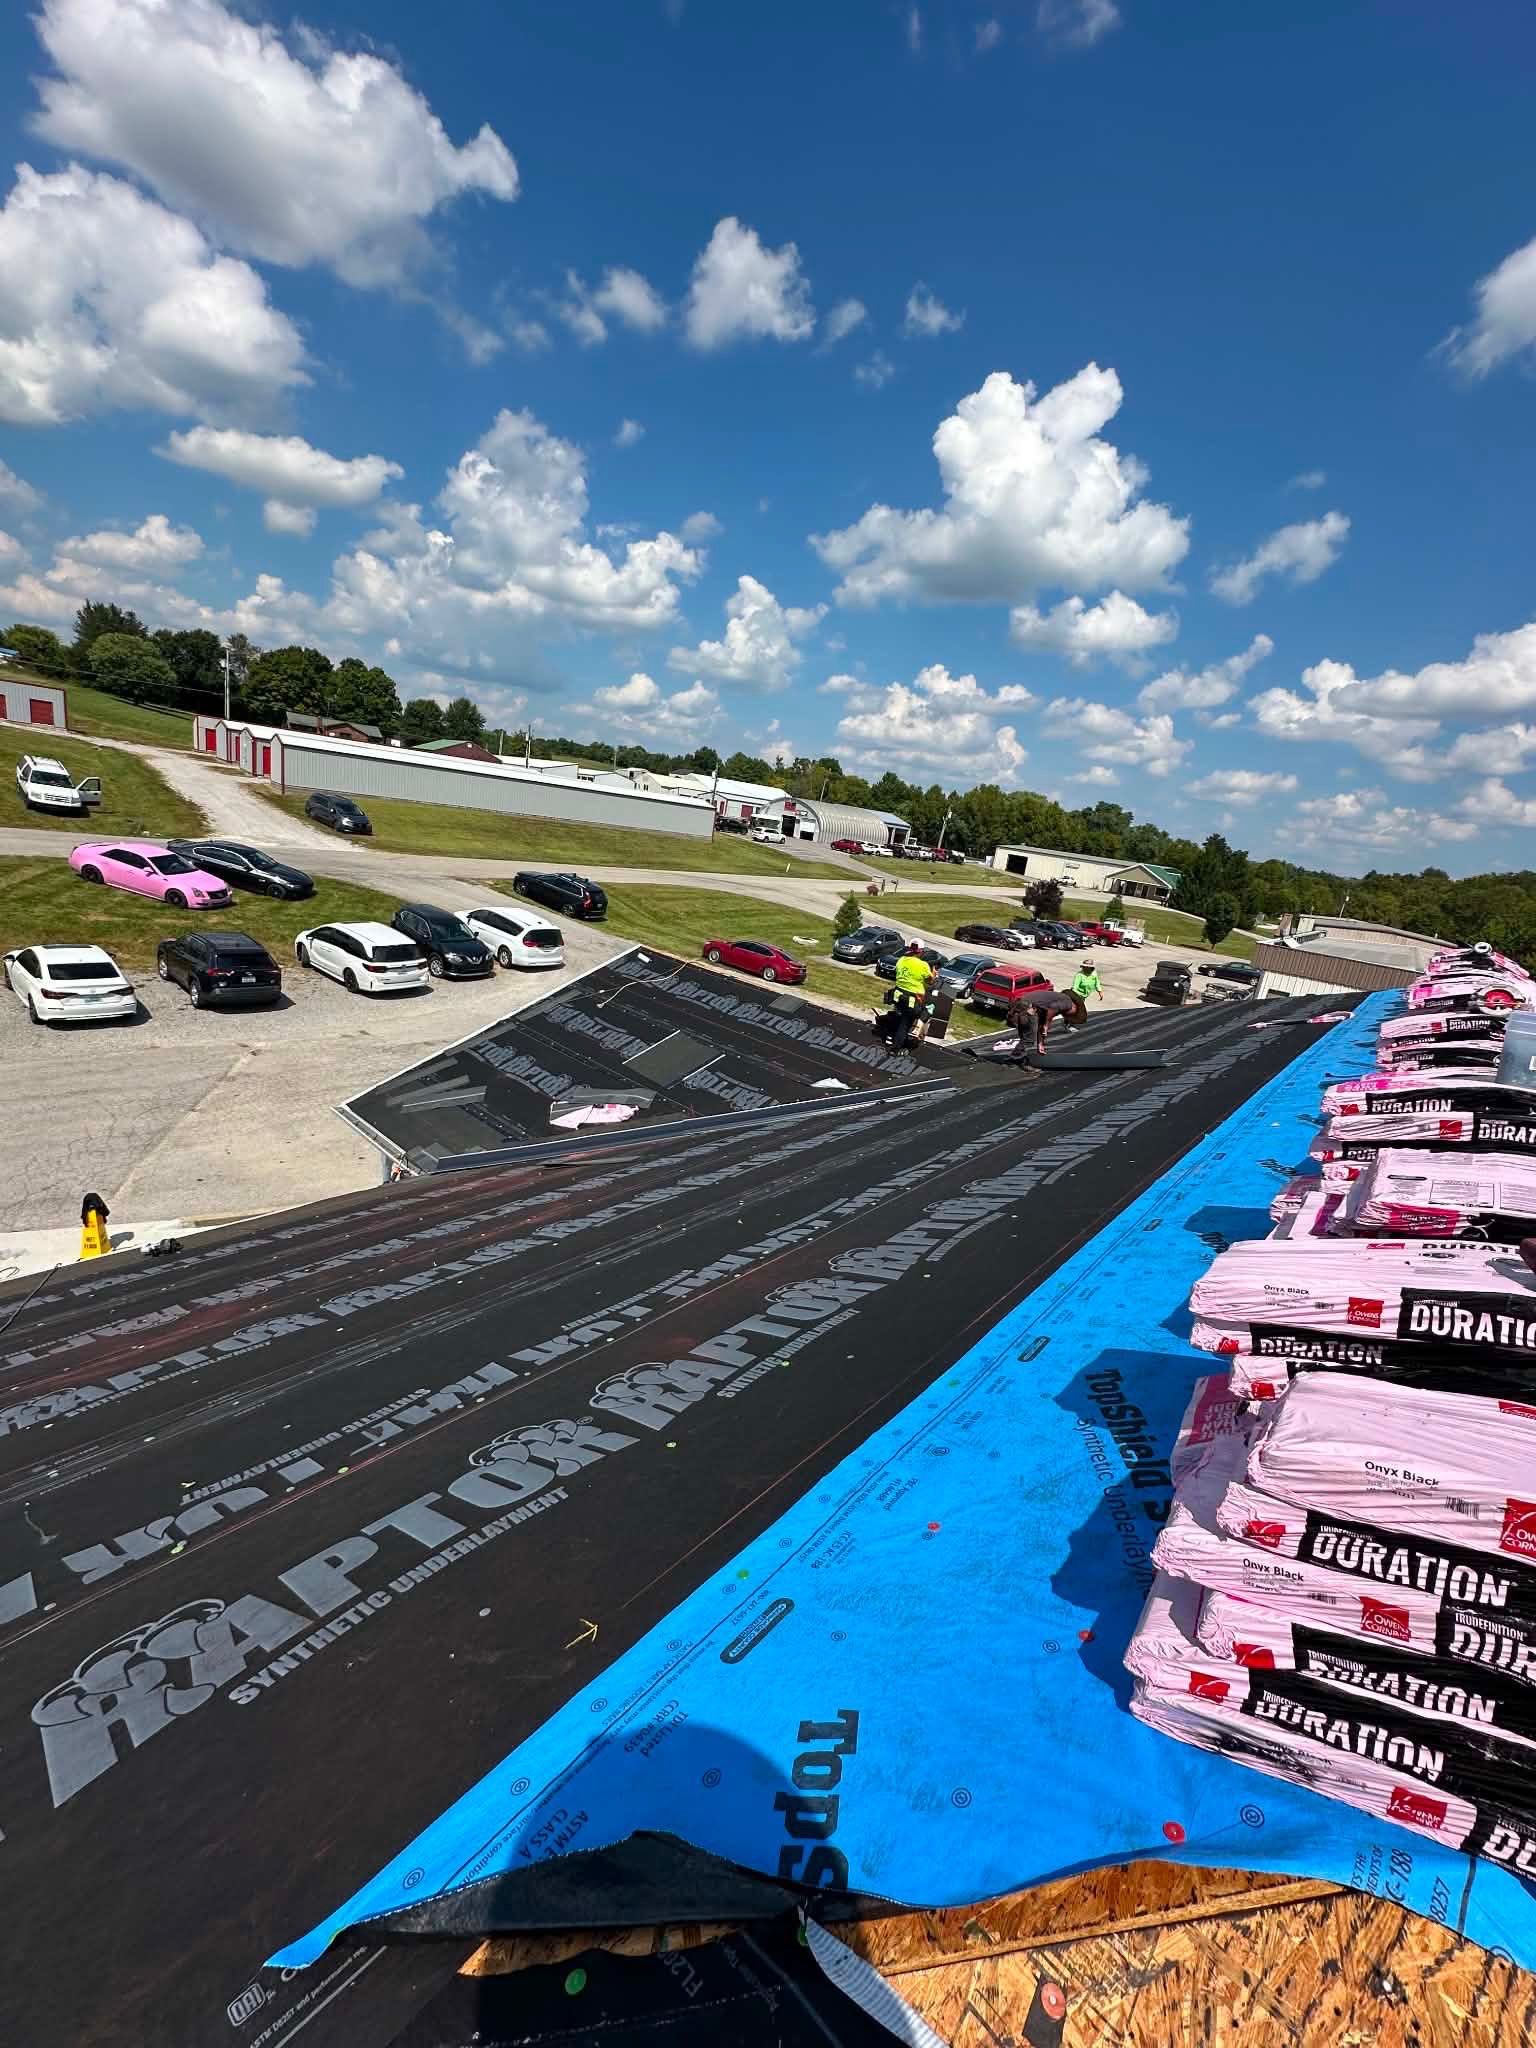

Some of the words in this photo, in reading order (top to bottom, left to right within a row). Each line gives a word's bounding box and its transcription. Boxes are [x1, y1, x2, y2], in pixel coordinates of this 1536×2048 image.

[1449, 1020, 1491, 1030] DURATION
[1371, 1099, 1452, 1113] DURATION
[1264, 1284, 1285, 1293] Onyx
[1287, 1287, 1310, 1295] Black
[589, 1277, 888, 1431] RAPTOR
[716, 1355, 783, 1398] SYNTHETIC
[774, 1308, 862, 1359] UNDERLAYMENT
[1260, 1337, 1384, 1364] DURATION
[341, 1387, 432, 1435] SYNTHETIC
[1085, 1368, 1176, 1488] TopShield
[1072, 1417, 1115, 1482] Synthetic
[180, 1432, 340, 1506] UNDERLAYMENT
[1364, 1460, 1400, 1480] Onyx
[1402, 1468, 1441, 1488] Black
[1242, 1558, 1270, 1577] Onyx
[1273, 1563, 1305, 1582] Black
[1311, 1531, 1510, 1607] DURATION
[228, 1589, 393, 1705] SYNTHETIC
[388, 1485, 569, 1593] UNDERLAYMENT
[31, 1417, 641, 1808] RAPTOR
[1455, 1612, 1524, 1641] TRUDEFINITION
[1307, 1650, 1364, 1672] TRUDEFINITION
[1304, 1659, 1496, 1723] DURATION
[652, 1697, 678, 1723] CCRR
[668, 1708, 688, 1728] TDI
[622, 1721, 654, 1753] #0439
[639, 1724, 672, 1758] Listed
[1254, 1701, 1444, 1781] DURATION
[501, 1815, 530, 1843] surface
[529, 1808, 567, 1847] CLASS
[552, 1810, 590, 1847] ASTM
[517, 1844, 532, 1860] A
[1356, 1851, 1367, 1873] THE
